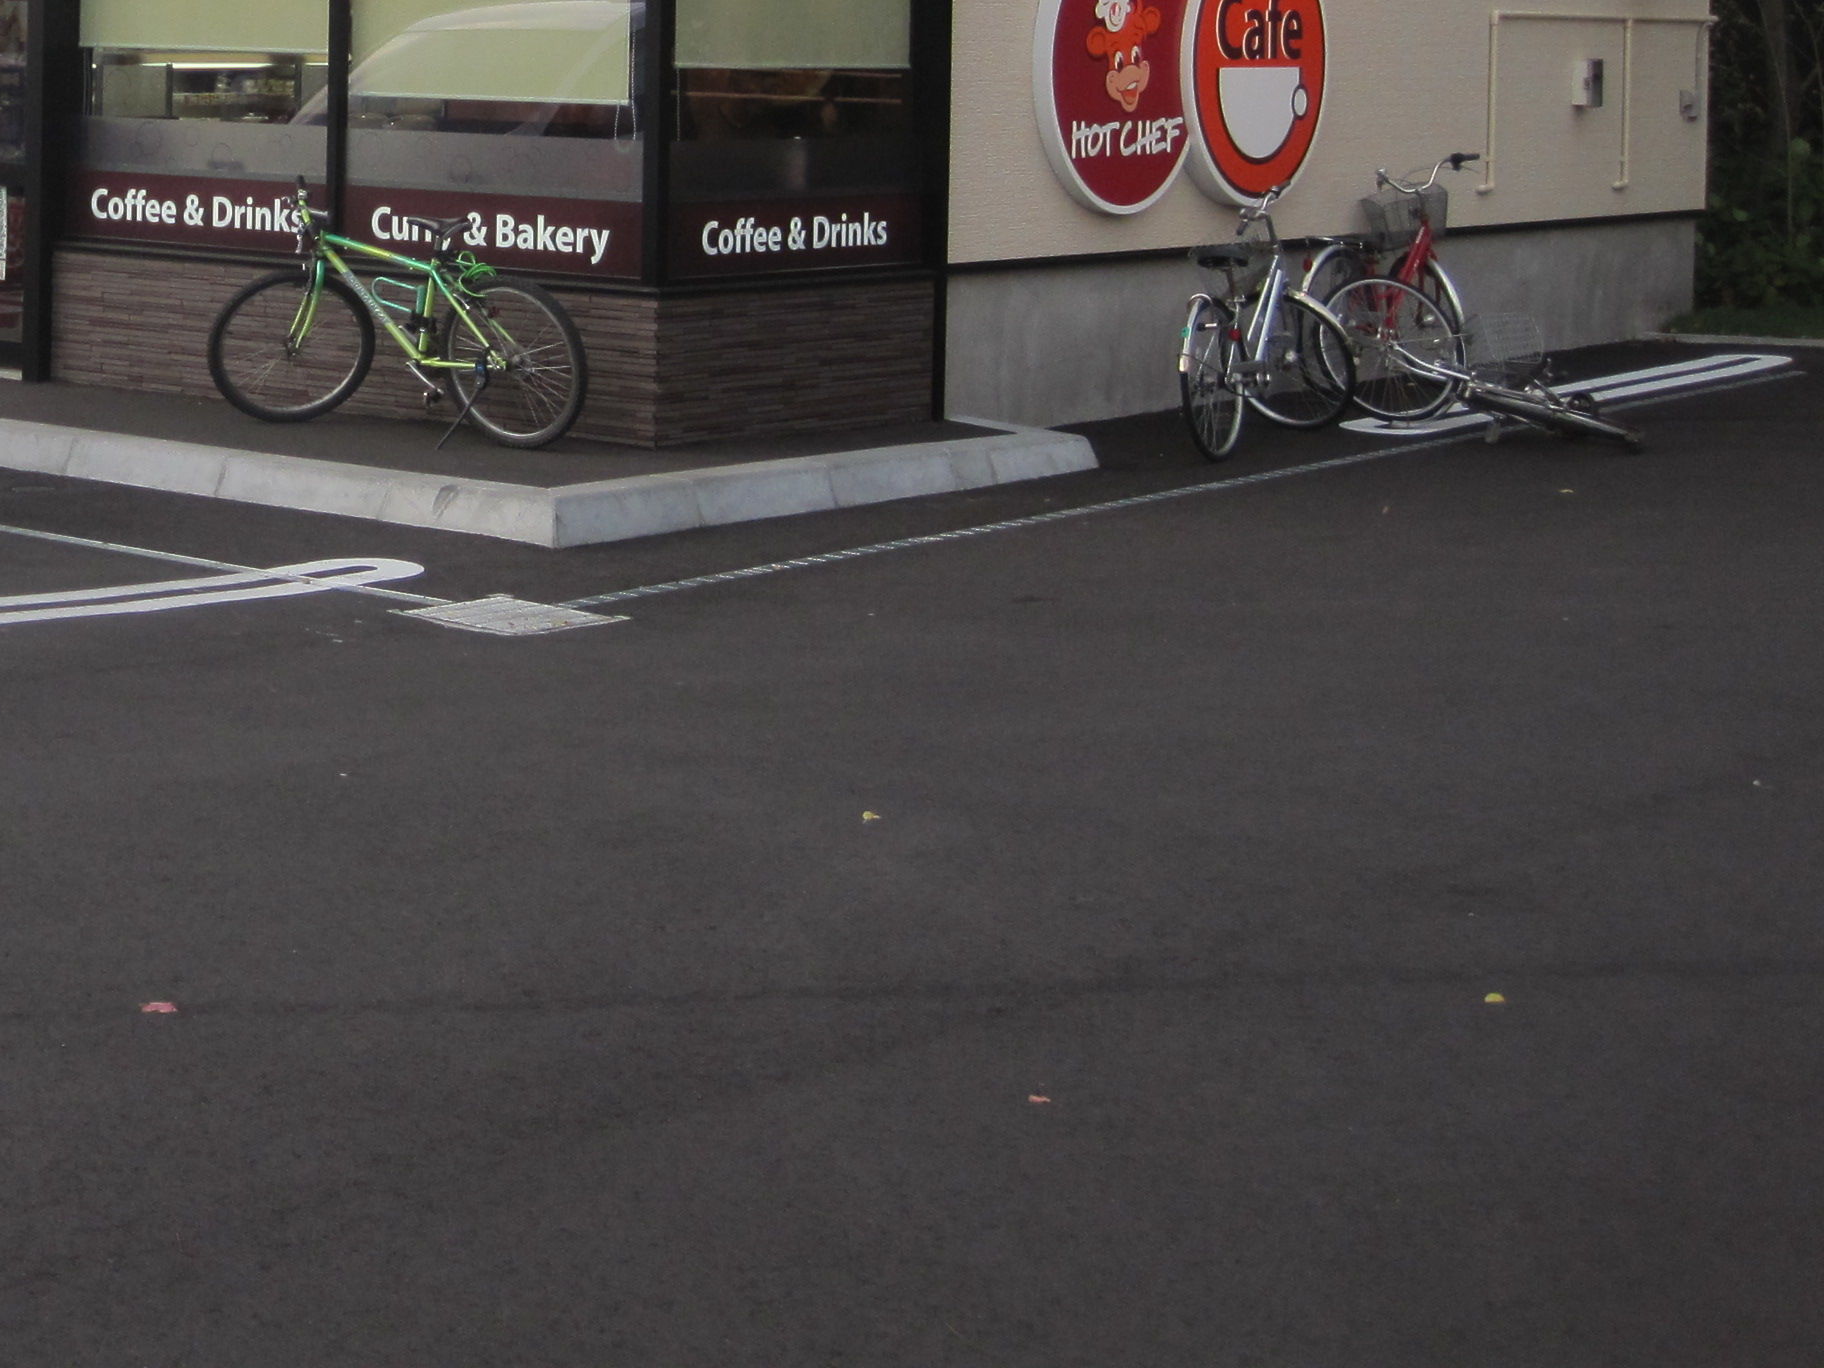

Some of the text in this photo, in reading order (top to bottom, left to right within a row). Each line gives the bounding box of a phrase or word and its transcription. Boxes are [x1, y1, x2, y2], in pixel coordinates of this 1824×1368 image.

[1071, 116, 1184, 159] HOT CHEF
[90, 188, 177, 224] Coffee
[183, 194, 204, 227] &
[496, 214, 611, 265] Bakery
[702, 211, 888, 256] Coffee & Drinks
